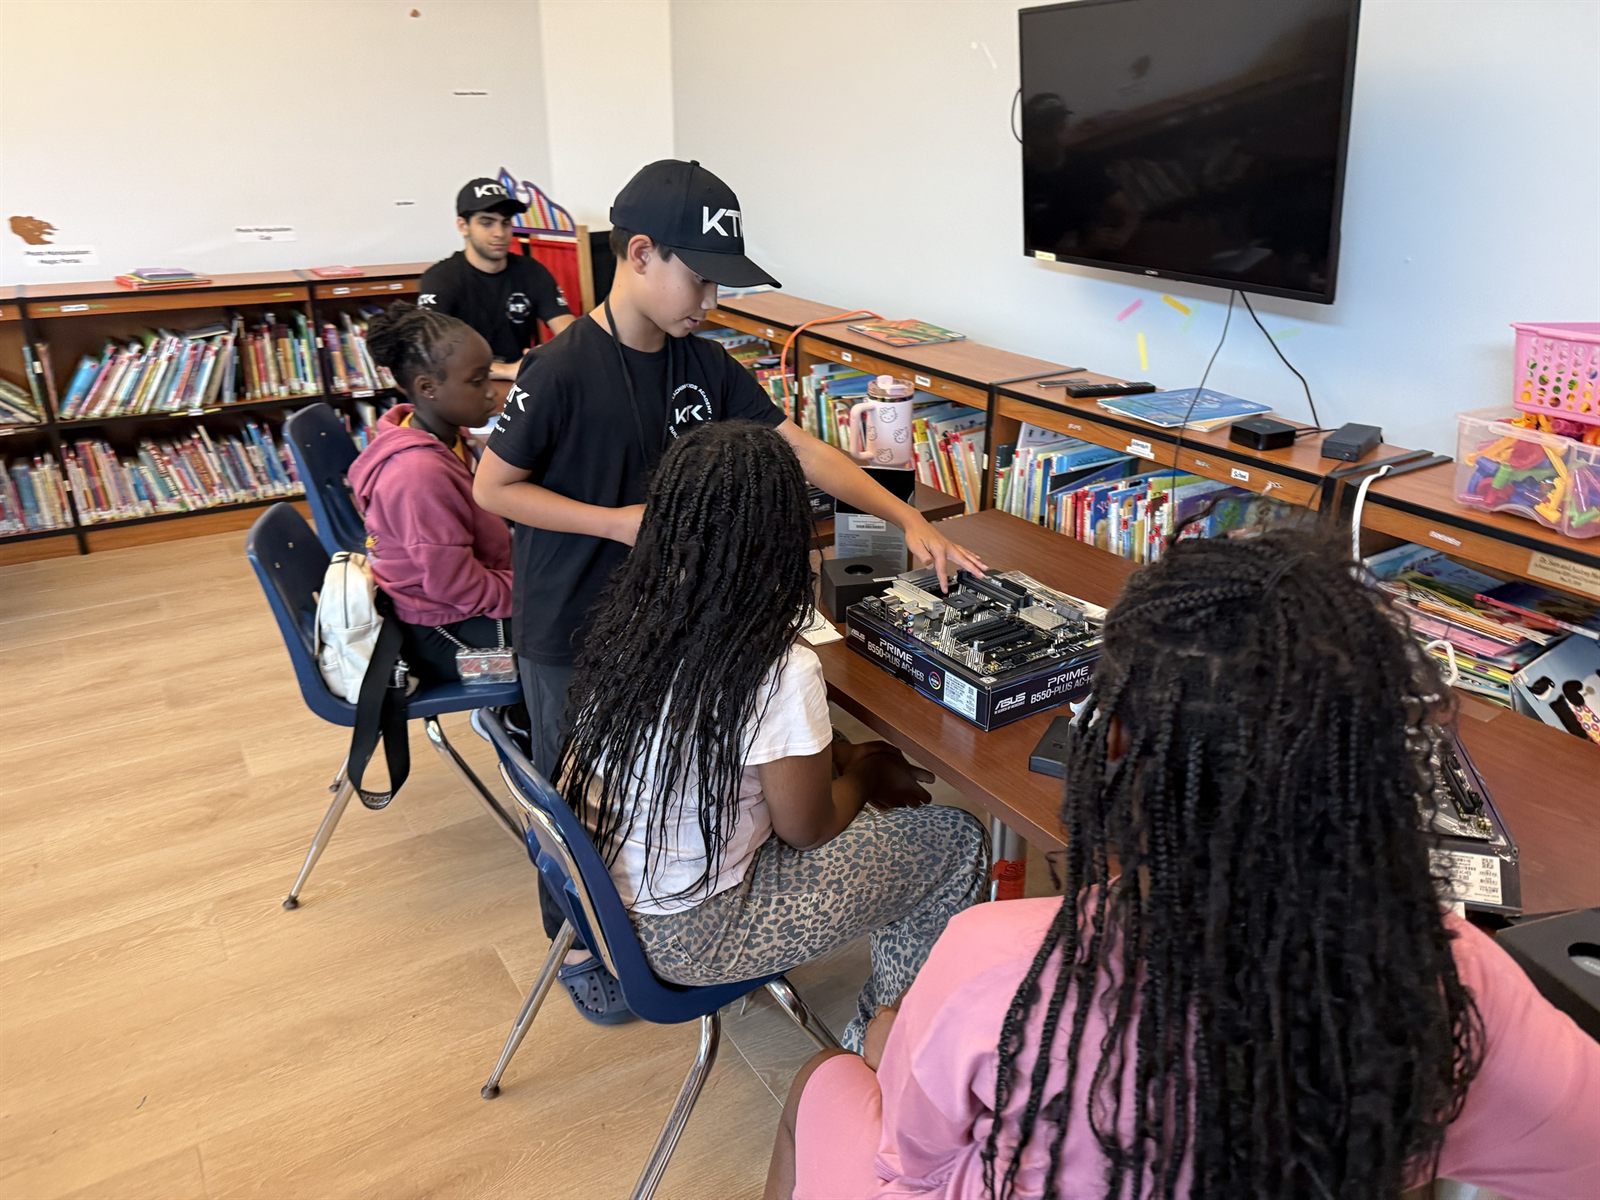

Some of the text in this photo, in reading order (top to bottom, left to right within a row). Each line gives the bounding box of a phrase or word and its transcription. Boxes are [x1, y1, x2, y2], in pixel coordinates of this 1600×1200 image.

[702, 206, 744, 238] KT
[867, 641, 901, 667] B550-PLUS
[901, 662, 925, 682] AC-HES
[879, 638, 913, 665] PRIME
[1047, 665, 1089, 688] PRIME
[994, 692, 1026, 711] ASUS
[1030, 681, 1073, 704] B550-PLUS
